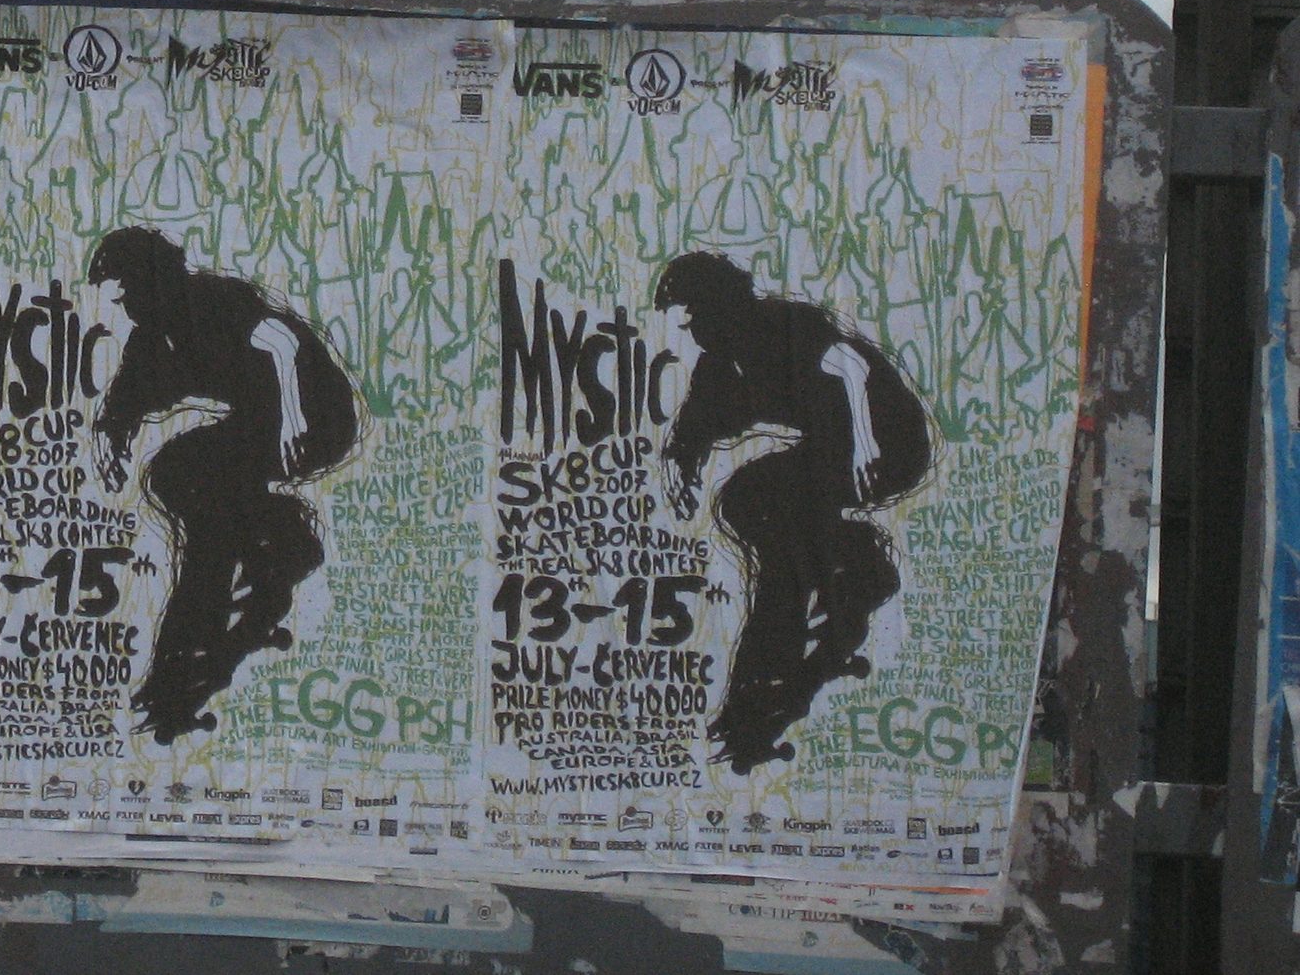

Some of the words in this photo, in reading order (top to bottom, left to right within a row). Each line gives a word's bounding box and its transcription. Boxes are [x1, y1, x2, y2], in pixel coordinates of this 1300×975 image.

[513, 60, 602, 98] VANS
[24, 409, 84, 446] CUP
[385, 421, 420, 443] LIVE
[27, 442, 79, 465] 2007
[44, 467, 87, 497] CUP
[436, 456, 484, 488] ISLAND
[498, 452, 589, 505] SK8
[592, 436, 653, 474] CUP
[596, 470, 649, 493] 2007
[331, 500, 425, 526] PRAGUE
[432, 476, 483, 518] CZECH
[497, 498, 609, 533] WORLD
[614, 495, 657, 525] CUP
[58, 523, 138, 547] CONTEST
[394, 521, 478, 538] EUROPEAN
[496, 522, 708, 560] SKATEBOARDING
[368, 548, 409, 565] BAD
[528, 555, 582, 574] REAL
[629, 551, 710, 575] CONTEST
[356, 581, 419, 601] STREET
[439, 583, 479, 605] VERT
[332, 595, 402, 615] BOWL
[404, 602, 475, 618] FINALS
[352, 614, 460, 634] SUNSHINE
[62, 685, 120, 701] FROM
[493, 683, 550, 710] PRIZE
[553, 685, 614, 712] MONEY
[60, 701, 124, 715] BRASIL
[228, 704, 267, 727] THE
[267, 668, 385, 738] EGG
[396, 695, 473, 744] PSH
[60, 714, 112, 726] ASIA
[64, 726, 78, 737] &
[81, 724, 120, 737] USA
[495, 712, 545, 747] PRO
[553, 713, 630, 731] RIDERS
[636, 715, 695, 731] FROM
[322, 734, 347, 747] ART
[635, 731, 700, 745] BRASIL
[845, 695, 965, 766] EGG
[977, 722, 1020, 771] PS
[551, 756, 636, 769] EUROPE
[656, 754, 696, 767] USA
[204, 787, 251, 802] Kingpin
[149, 812, 186, 824] LEVEL
